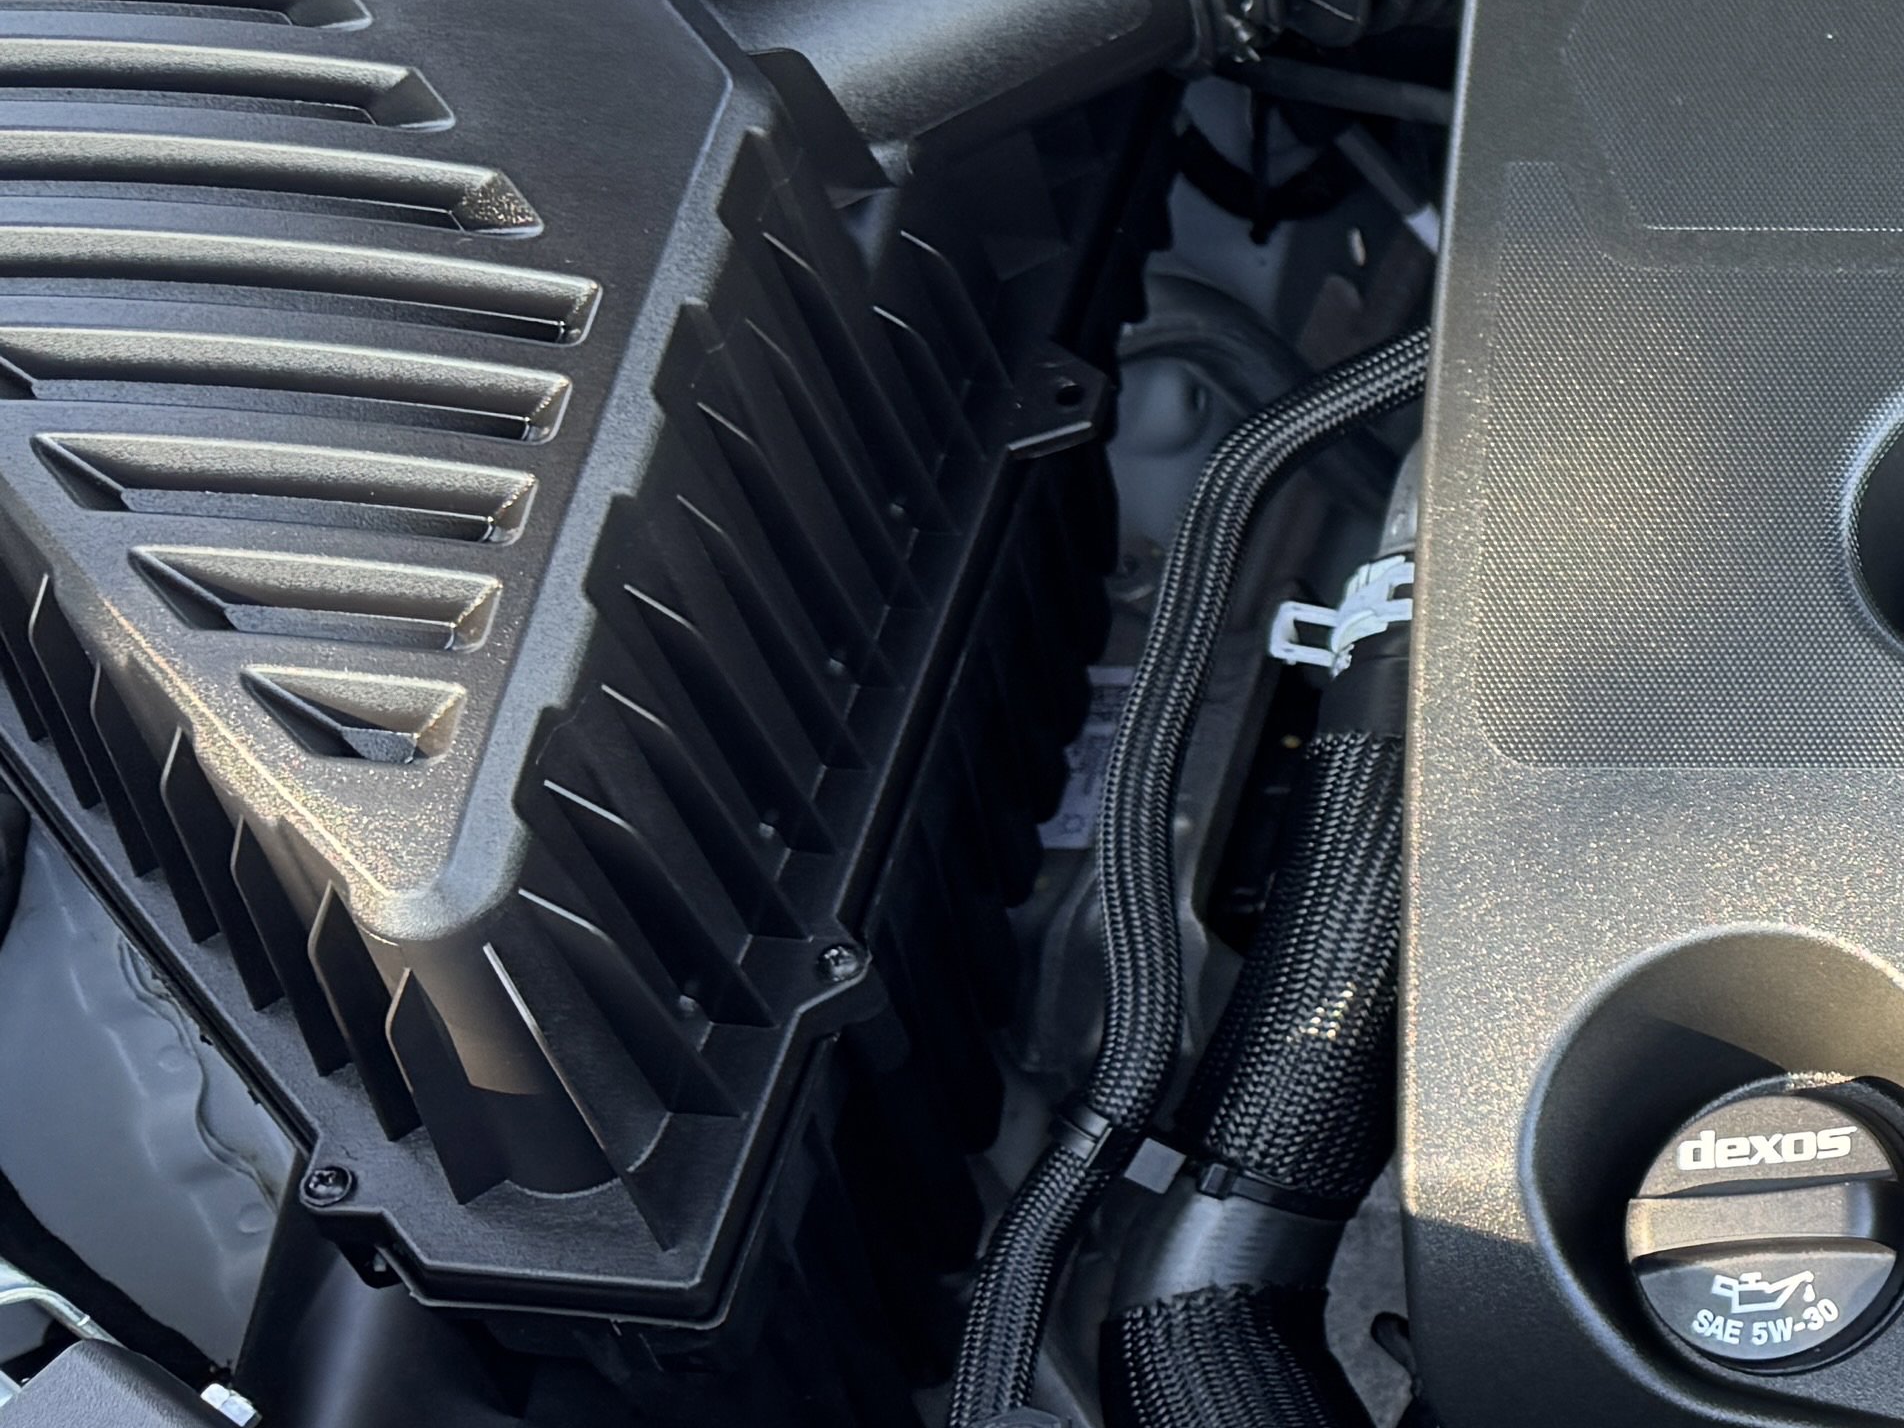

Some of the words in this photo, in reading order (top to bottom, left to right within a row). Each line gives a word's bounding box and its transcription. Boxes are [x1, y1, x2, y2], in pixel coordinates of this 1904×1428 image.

[1676, 1125, 1858, 1171] dexos
[1692, 1308, 1744, 1345] SAE
[1751, 1299, 1840, 1346] 5W-30
